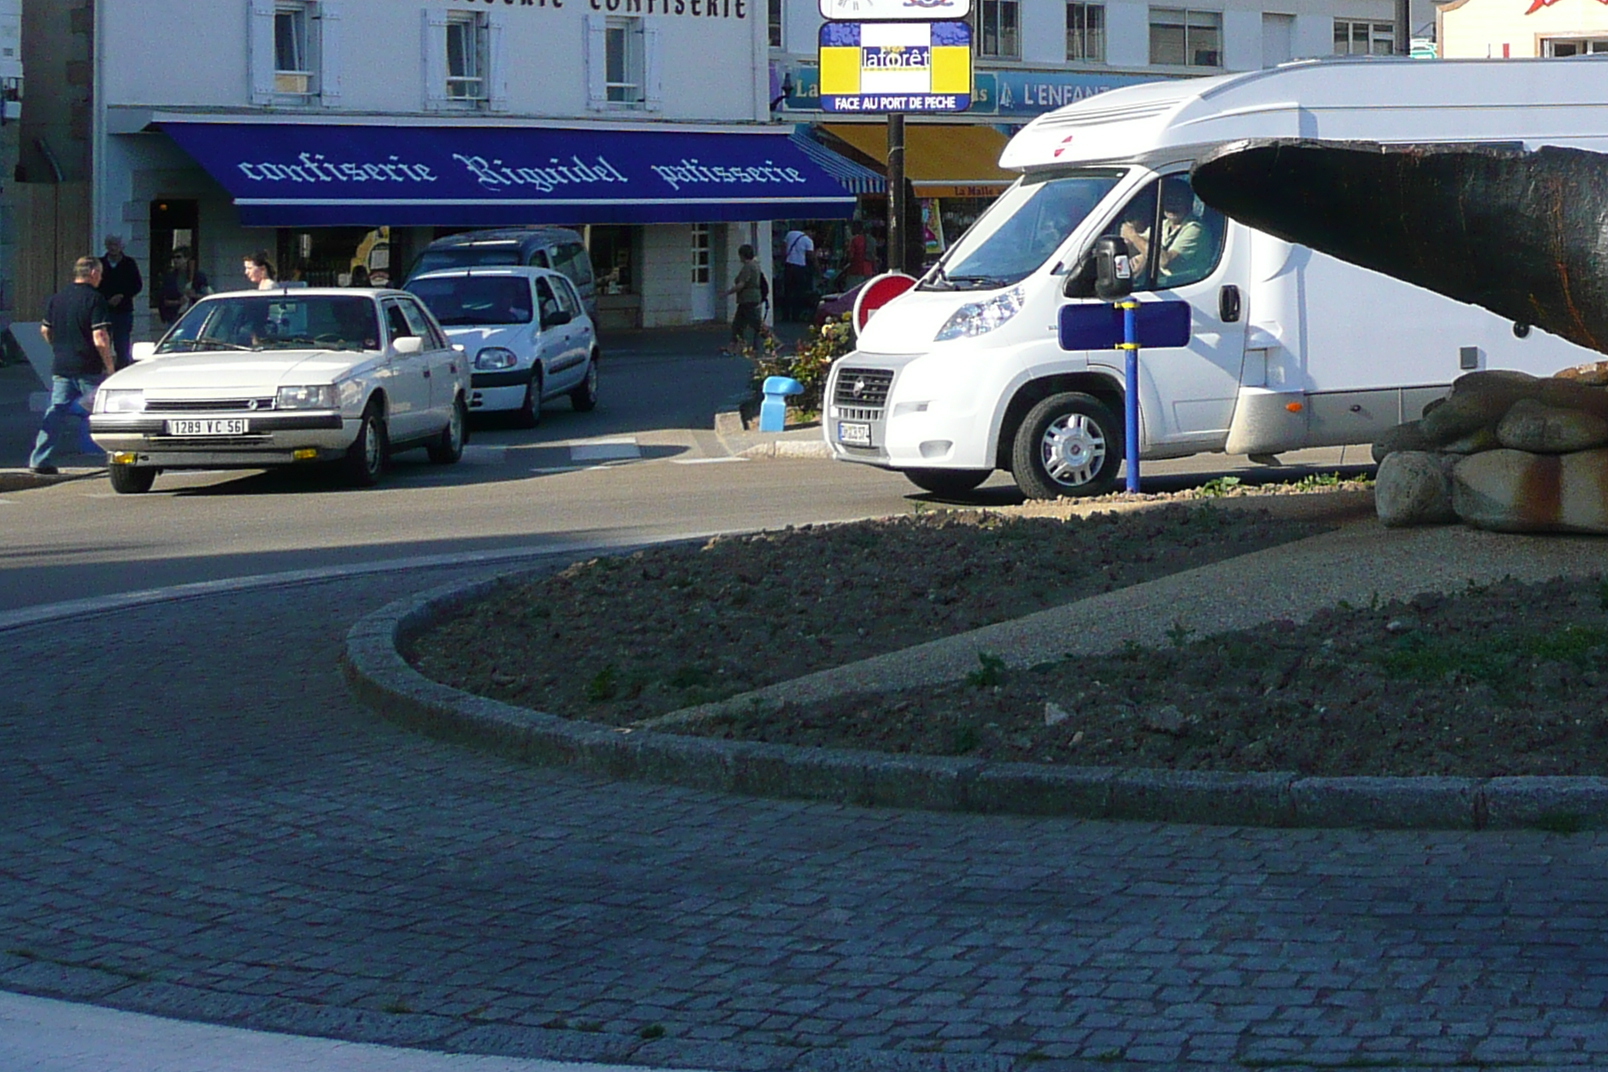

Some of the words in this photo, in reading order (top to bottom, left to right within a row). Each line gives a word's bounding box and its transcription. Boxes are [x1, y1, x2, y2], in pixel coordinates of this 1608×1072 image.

[863, 47, 930, 68] laforêt
[835, 97, 860, 110] FACE
[862, 97, 877, 110] AU
[880, 96, 908, 110] PORT
[909, 96, 923, 109] DE
[925, 96, 956, 109] PECHE
[237, 151, 438, 183] confiserie
[452, 153, 629, 193] Riguidel
[174, 420, 202, 434] 1289
[206, 420, 222, 433] VC
[227, 420, 241, 433] 56
